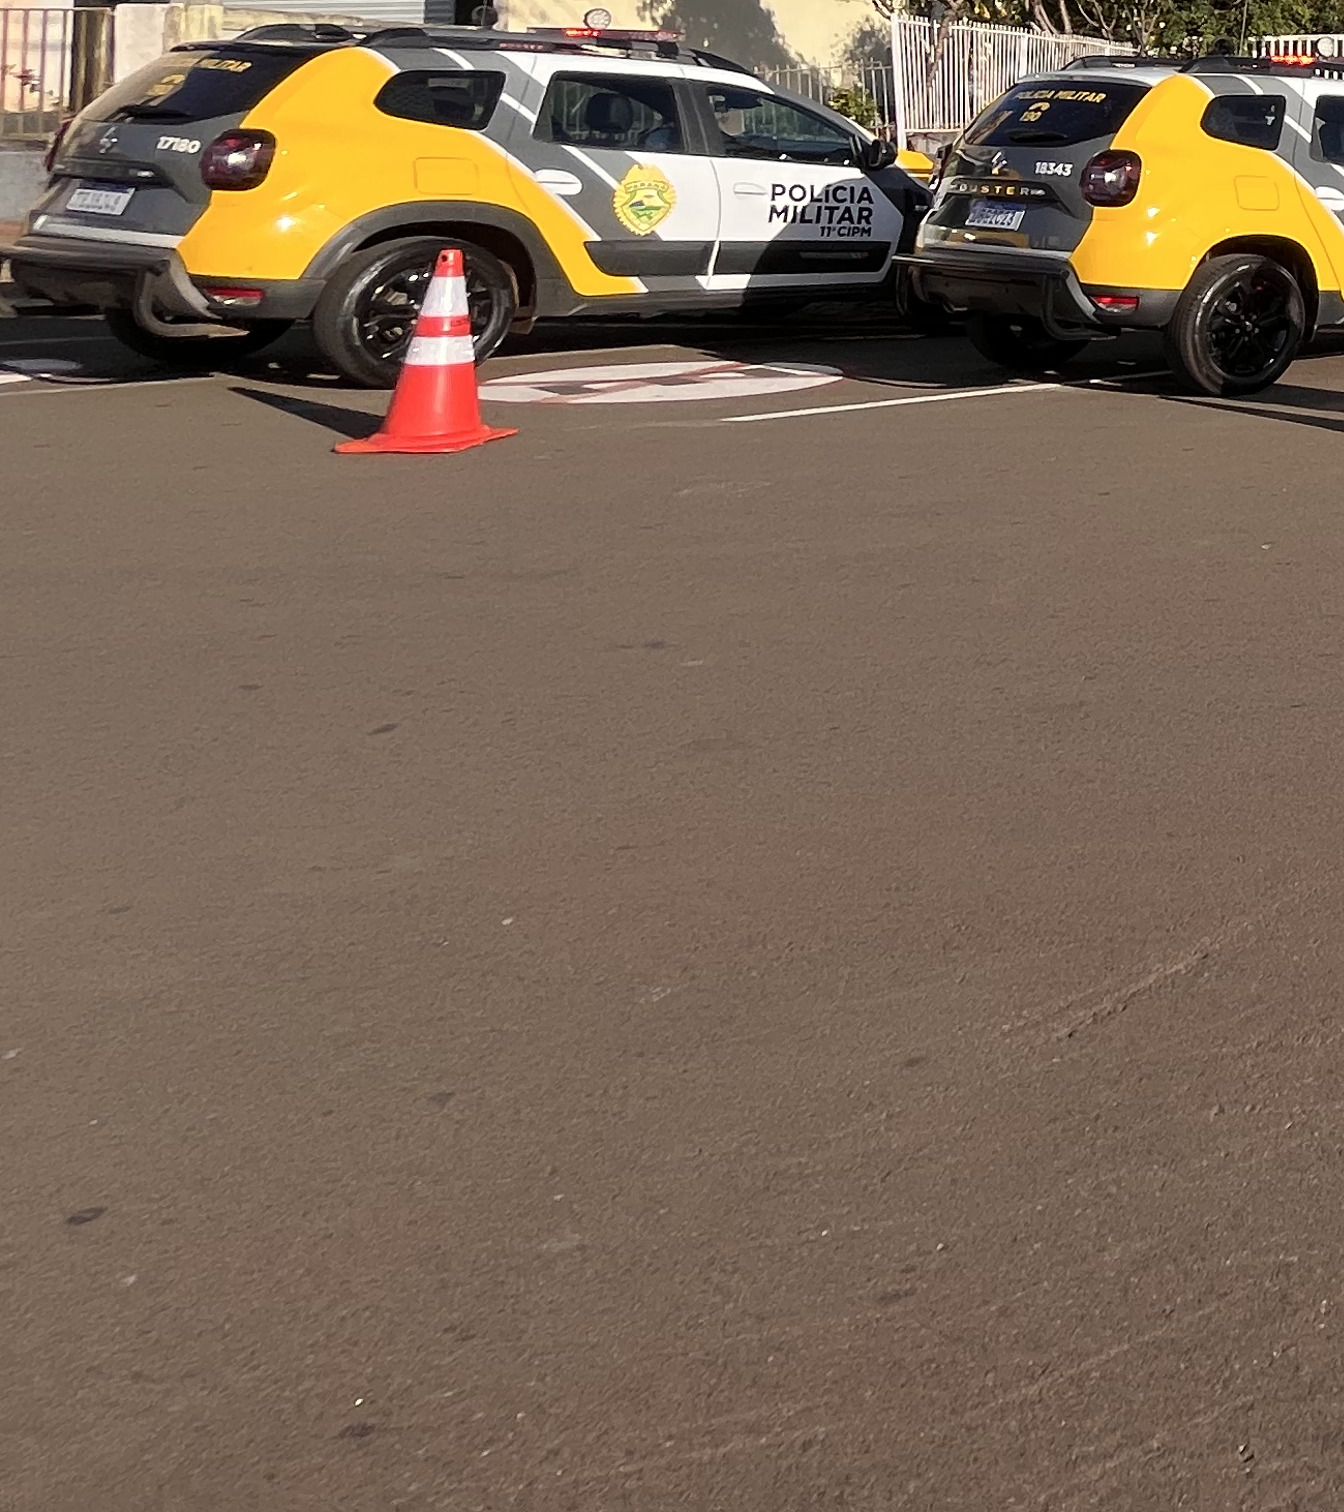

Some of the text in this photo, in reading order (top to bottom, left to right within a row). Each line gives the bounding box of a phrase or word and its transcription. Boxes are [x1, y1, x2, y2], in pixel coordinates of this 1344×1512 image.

[1035, 161, 1073, 177] 18343
[771, 183, 874, 205] POLÍCIA
[959, 183, 1030, 196] DUSTER
[768, 204, 873, 225] MILITAR
[840, 226, 872, 237] CIPM
